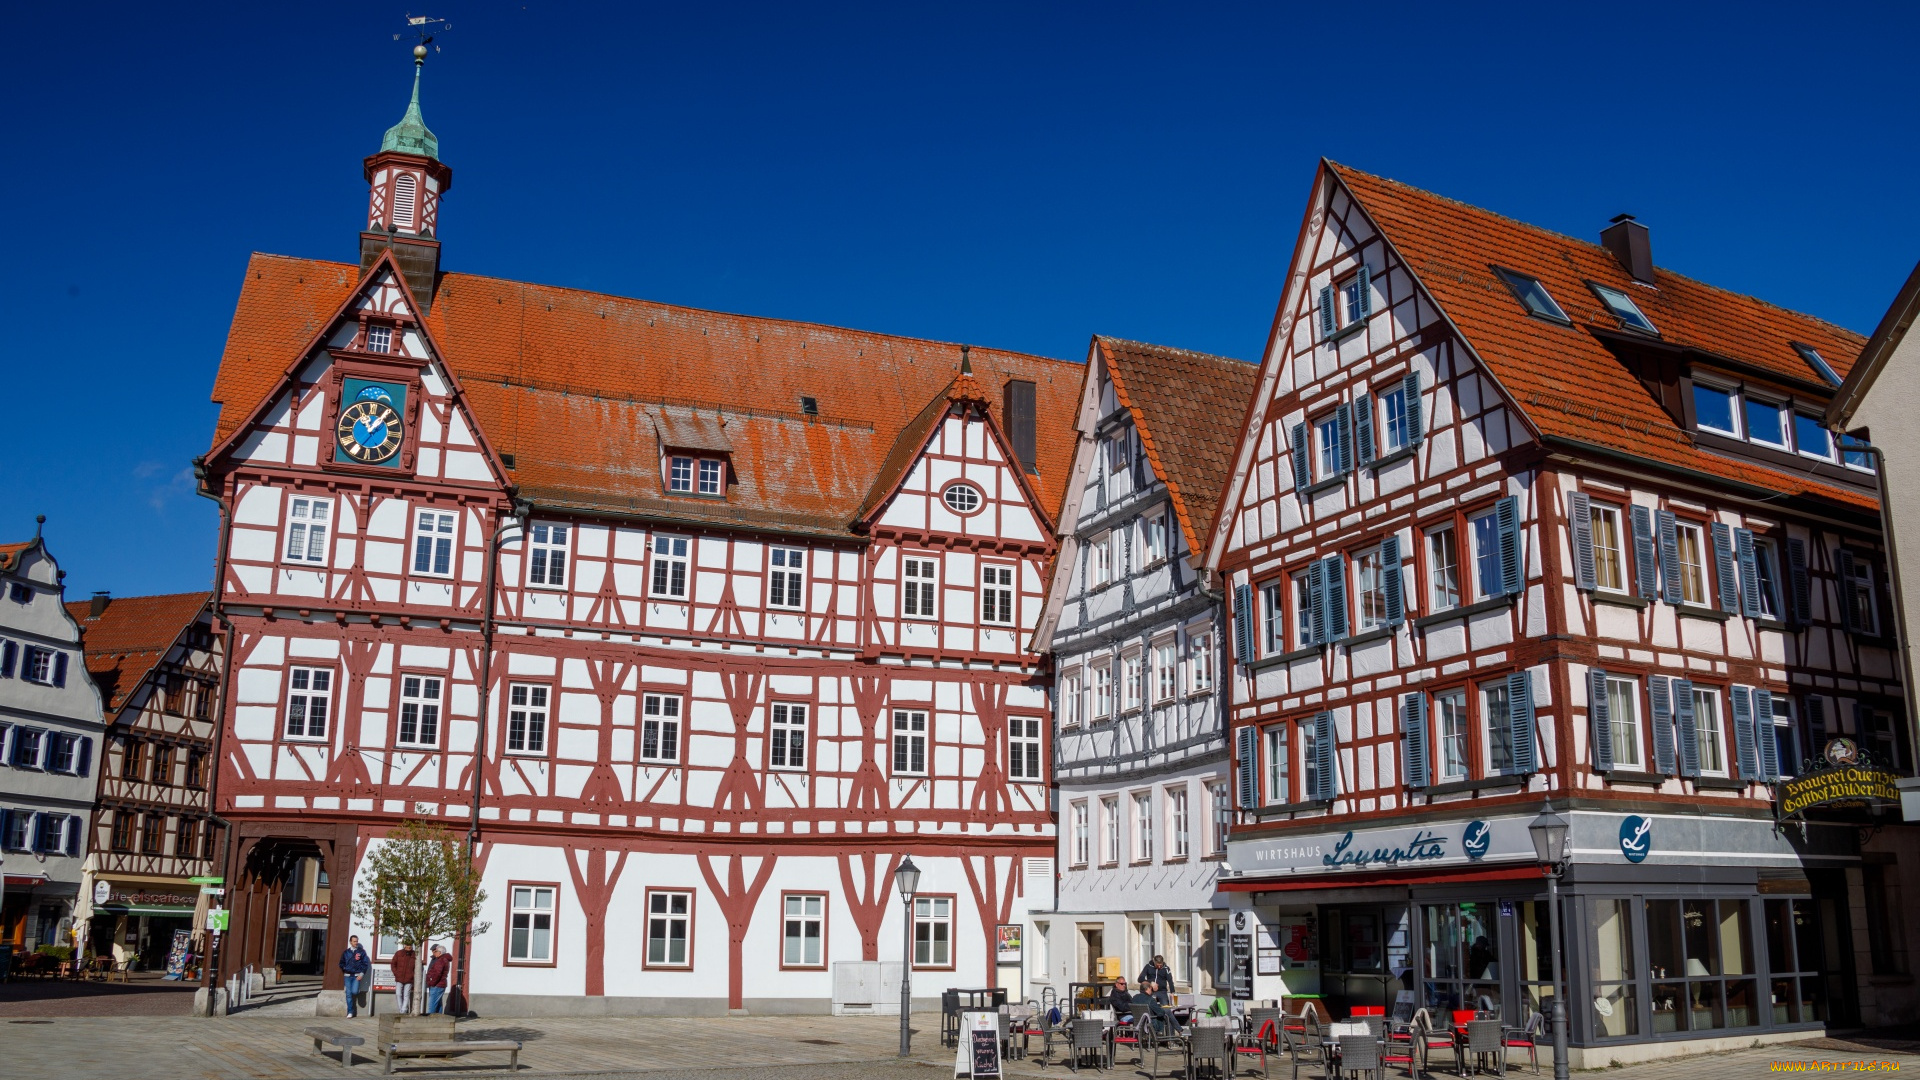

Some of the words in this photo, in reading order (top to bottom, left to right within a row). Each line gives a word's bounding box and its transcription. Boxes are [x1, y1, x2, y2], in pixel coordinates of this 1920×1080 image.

[1786, 769, 1845, 796] Brauerei
[1846, 768, 1904, 785] Quenze
[1830, 783, 1874, 798] Wilder
[1255, 846, 1321, 861] WIRTSHAUS
[1323, 830, 1449, 867] Laurentia
[109, 891, 127, 902] afe
[281, 903, 328, 913] CHUMAC
